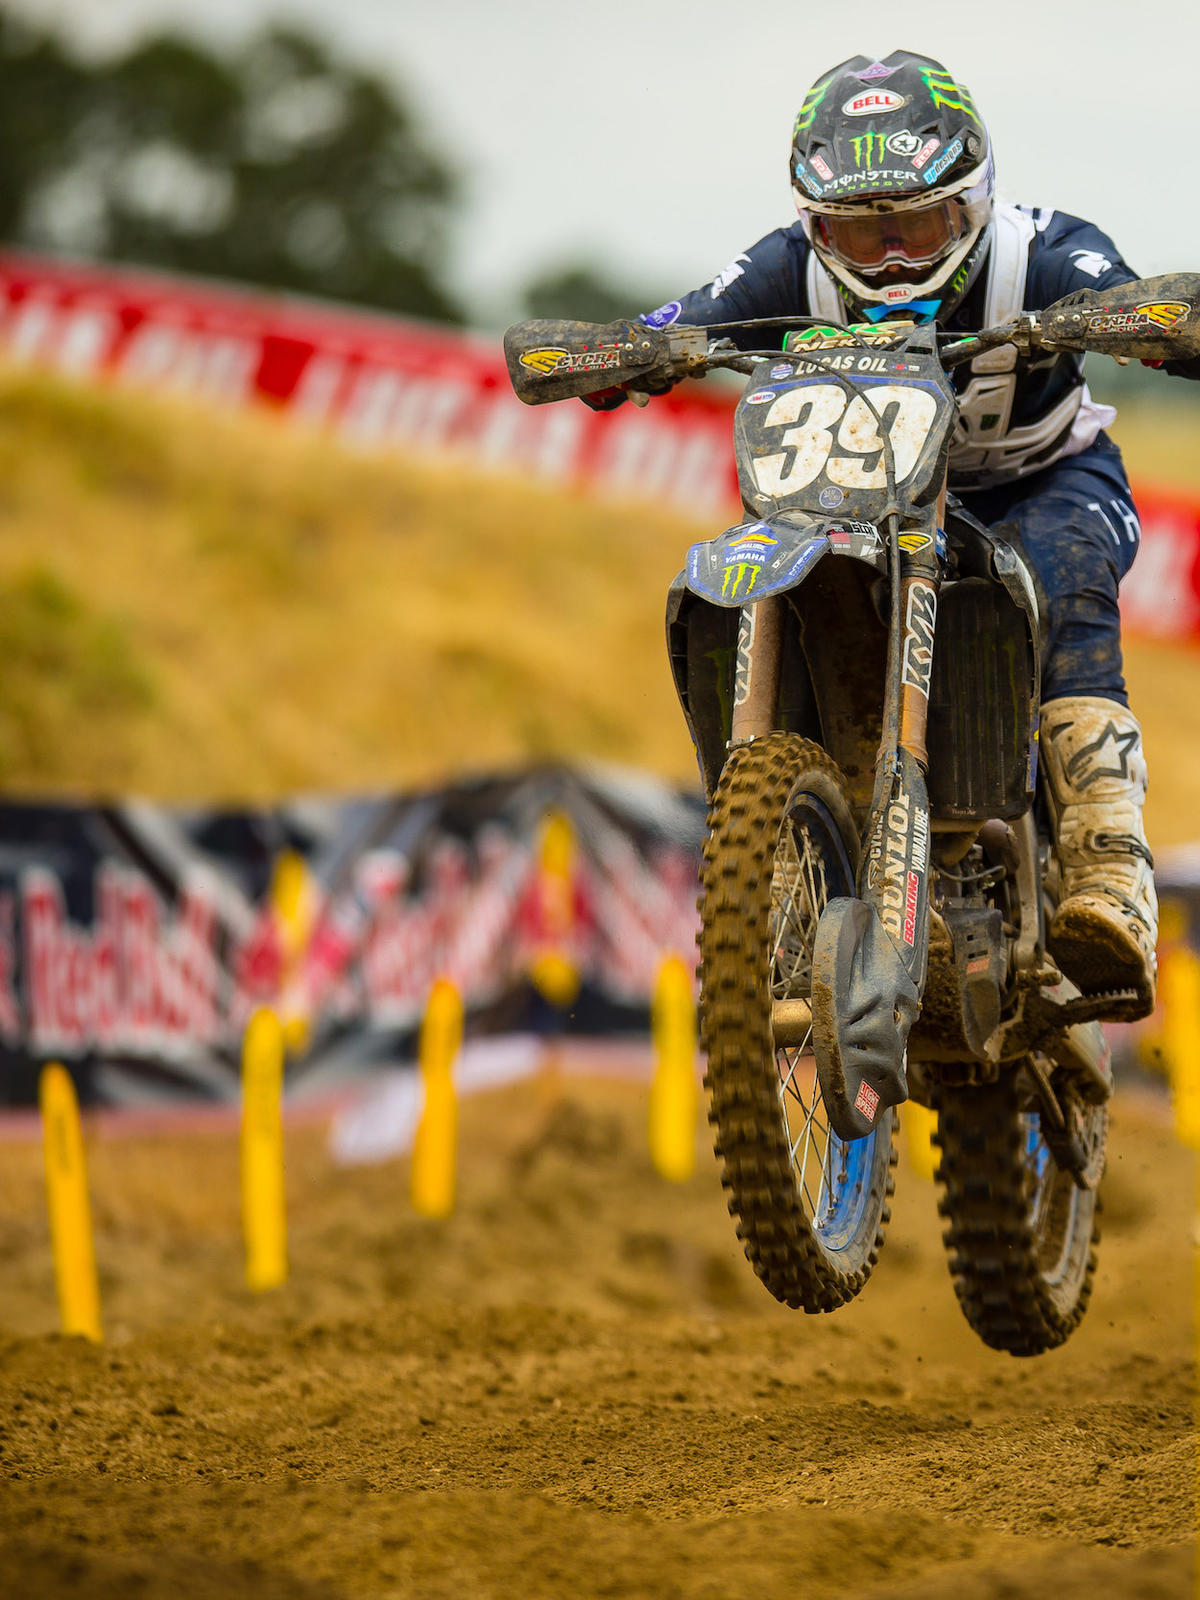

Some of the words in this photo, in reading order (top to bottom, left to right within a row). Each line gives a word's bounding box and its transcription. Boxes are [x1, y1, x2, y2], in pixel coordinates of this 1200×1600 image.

[852, 95, 896, 111] BELL
[887, 289, 908, 299] BELL
[794, 355, 856, 376] LUCAS
[857, 356, 889, 373] OIL
[752, 384, 938, 499] 39
[725, 552, 766, 564] YAMAHA
[911, 806, 929, 874] YAMALUBE
[903, 870, 920, 948] BRAKING
[855, 1095, 875, 1120] SPEED
[859, 1082, 880, 1109] LIGHT
